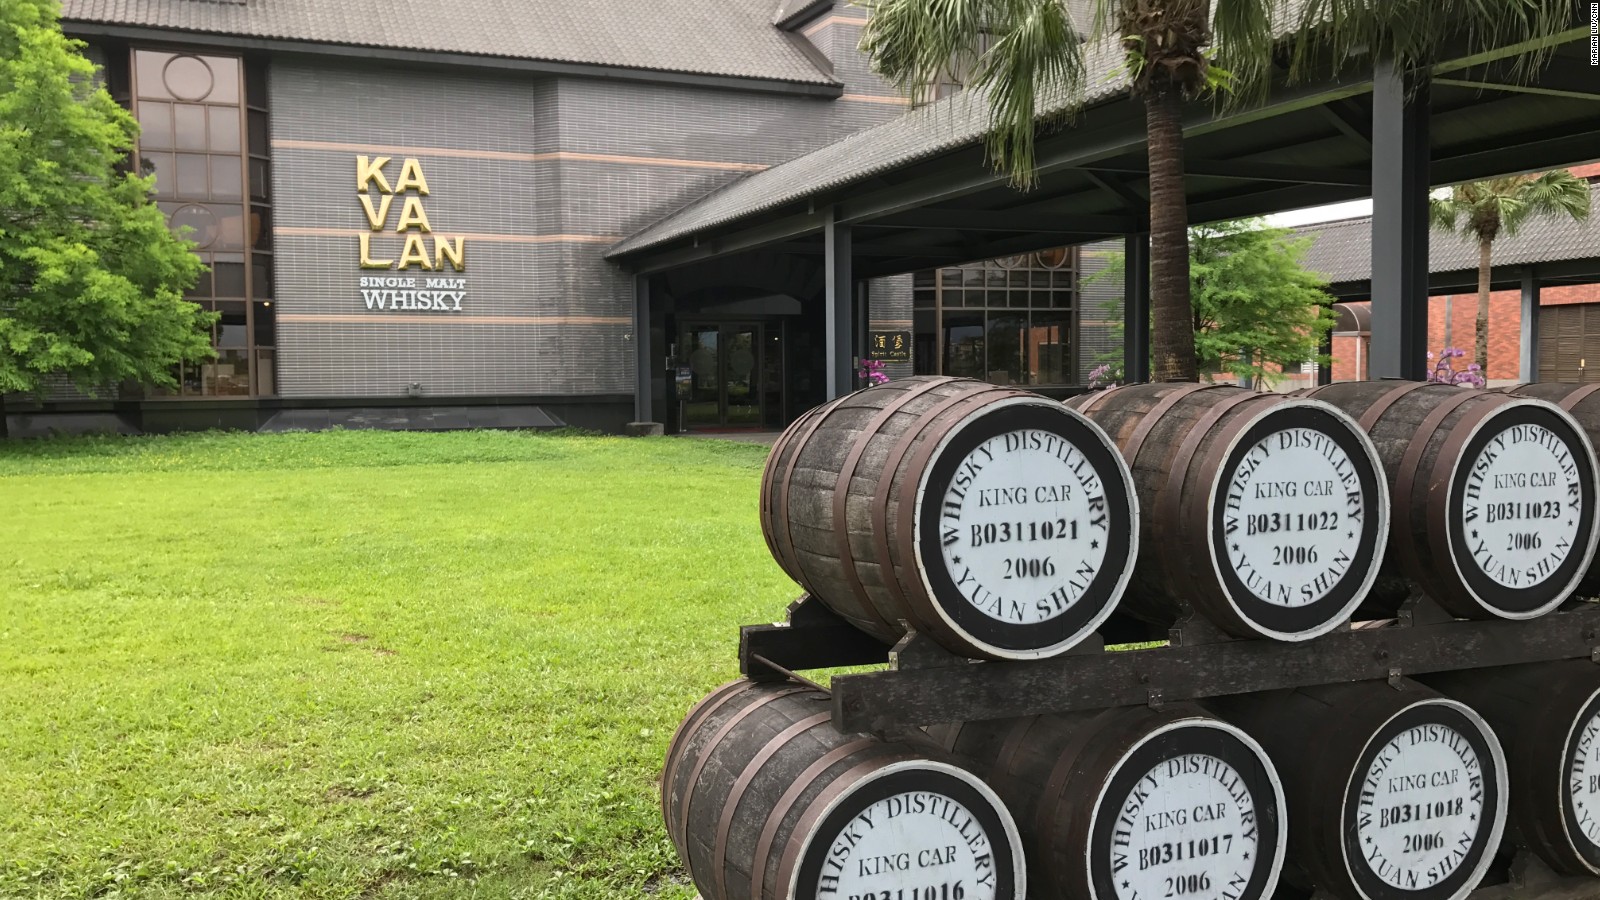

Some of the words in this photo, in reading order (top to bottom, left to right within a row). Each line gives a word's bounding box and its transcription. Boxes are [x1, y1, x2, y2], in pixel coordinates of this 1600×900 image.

[356, 155, 430, 195] KA
[357, 194, 432, 233] VA
[359, 232, 465, 272] LAN
[360, 277, 415, 288] SINGLE
[426, 278, 466, 289] MALT
[360, 289, 467, 311] WHISKY
[943, 437, 997, 547] WHISKY
[1004, 431, 1106, 532] DISTILLERY
[1226, 436, 1273, 535] WHISKY
[1279, 430, 1361, 523] DISTILLERY
[1254, 482, 1297, 499] KING
[1304, 480, 1333, 496] CAR
[1465, 433, 1507, 526] WHISKY
[1512, 425, 1579, 512] DISTILLERY
[1494, 473, 1526, 489] KING
[1530, 472, 1557, 487] CAR
[979, 487, 1027, 507] KING
[1035, 485, 1071, 503] CAR
[1486, 501, 1561, 523] B0311023
[971, 518, 1078, 547] B0311021
[1247, 511, 1338, 536] B0311022
[1272, 545, 1318, 565] 2006
[1507, 531, 1542, 551] 2006
[1003, 556, 1055, 579] 2006
[1235, 554, 1292, 605] YUAN
[1301, 549, 1350, 603] SHAN
[1472, 538, 1522, 586] YUAN
[1526, 536, 1570, 585] SHAN
[956, 567, 1025, 622] YUAN
[1036, 559, 1095, 620] SHAN
[1572, 713, 1600, 795] WHISK
[1360, 734, 1405, 831] WHISKY
[1410, 725, 1483, 805] DISTILLERY
[1388, 774, 1426, 793] KING
[1431, 769, 1459, 787] CAR
[1113, 763, 1163, 874] WHISKY
[1168, 755, 1256, 842] DISTILLERY
[1145, 809, 1187, 832] KING
[1193, 802, 1226, 823] CAR
[1380, 797, 1463, 829] B0311018
[818, 803, 880, 900] HISKY
[887, 793, 994, 889] DISTILLERY
[1139, 834, 1233, 871] B0311017
[1403, 831, 1444, 853] 2006
[858, 852, 910, 877] KING
[918, 845, 957, 867] CAR
[1368, 845, 1420, 889] YUAN
[1427, 831, 1472, 885] SHAN
[1164, 870, 1211, 898] 2006
